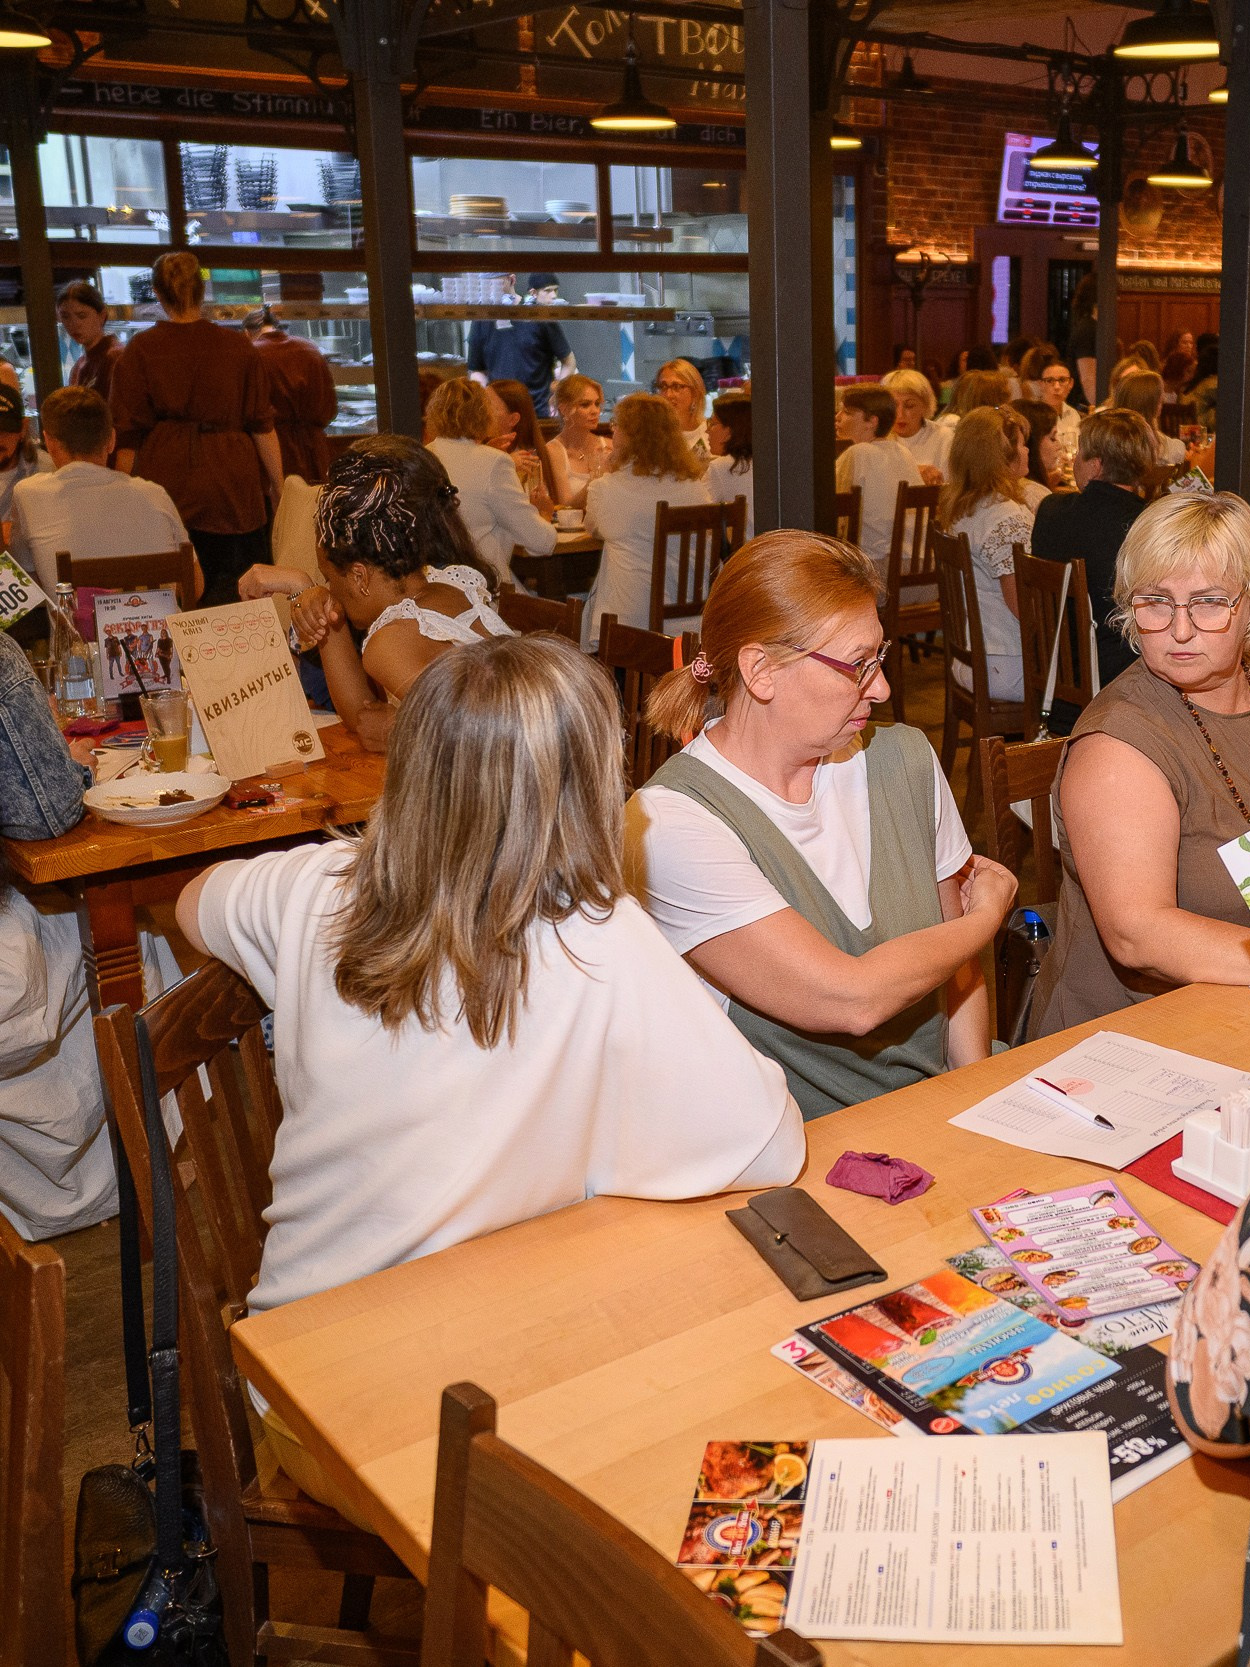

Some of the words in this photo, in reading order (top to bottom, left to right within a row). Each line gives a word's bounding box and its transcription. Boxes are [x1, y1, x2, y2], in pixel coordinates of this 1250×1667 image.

[177, 88, 214, 108] die
[480, 109, 517, 129] Ein
[530, 112, 584, 135] Bier,
[700, 124, 737, 142] dich
[182, 626, 203, 637] КВИЗ
[203, 662, 292, 722] КВИЗАНУТЫЕ
[1110, 1434, 1168, 1465] -50%
